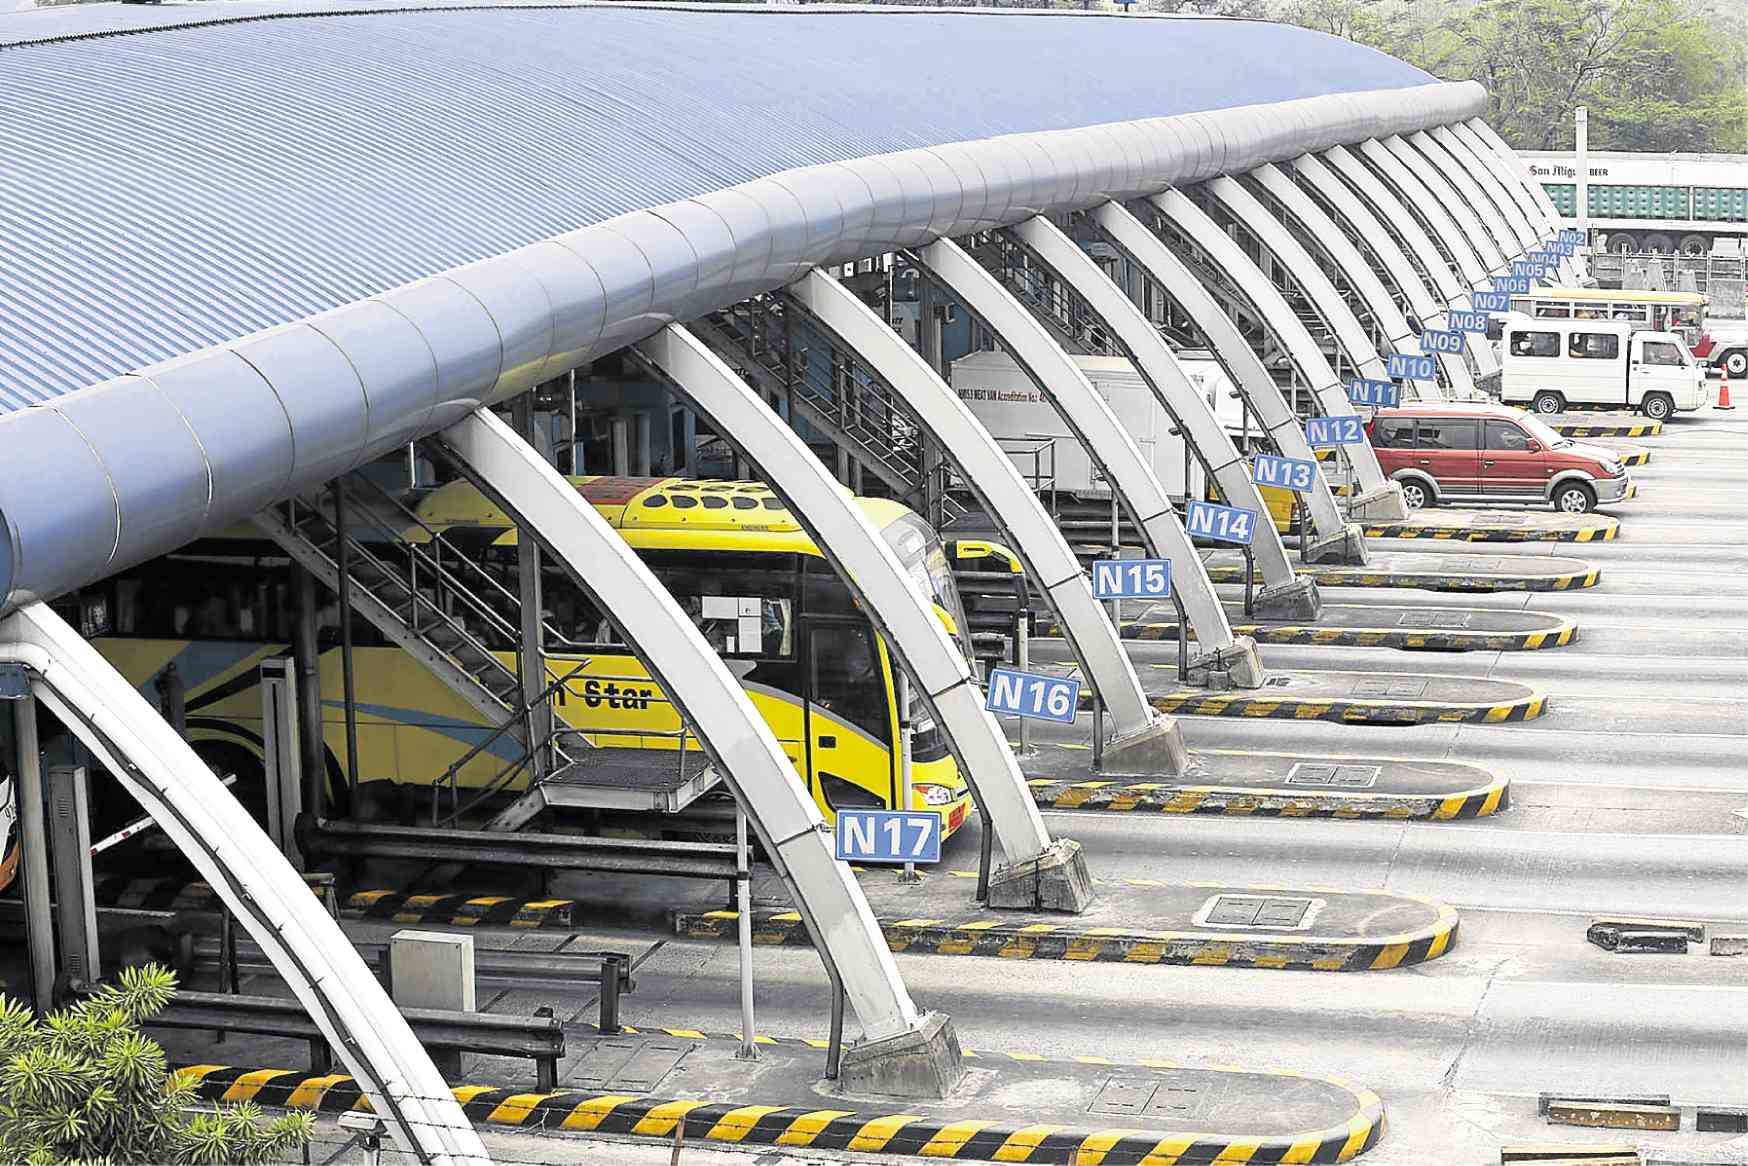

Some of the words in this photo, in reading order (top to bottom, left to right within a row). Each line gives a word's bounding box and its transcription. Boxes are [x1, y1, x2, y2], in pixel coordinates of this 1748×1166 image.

[1529, 165, 1550, 176] San
[1560, 231, 1585, 245] N02
[1530, 253, 1558, 265] N04
[1547, 242, 1572, 256] N03
[1515, 263, 1544, 277] N05
[1495, 278, 1528, 292] N06
[1474, 294, 1507, 310] N07
[1450, 313, 1486, 331] N08
[1423, 332, 1461, 352] N09
[1390, 356, 1432, 378] N10
[1352, 381, 1398, 405] N11
[1310, 420, 1359, 443] N12
[1255, 457, 1311, 488] N13
[1190, 505, 1249, 539] N14
[1097, 564, 1165, 594] N15
[584, 680, 652, 710] Star
[991, 673, 1071, 717] N16
[843, 815, 934, 857] N17
